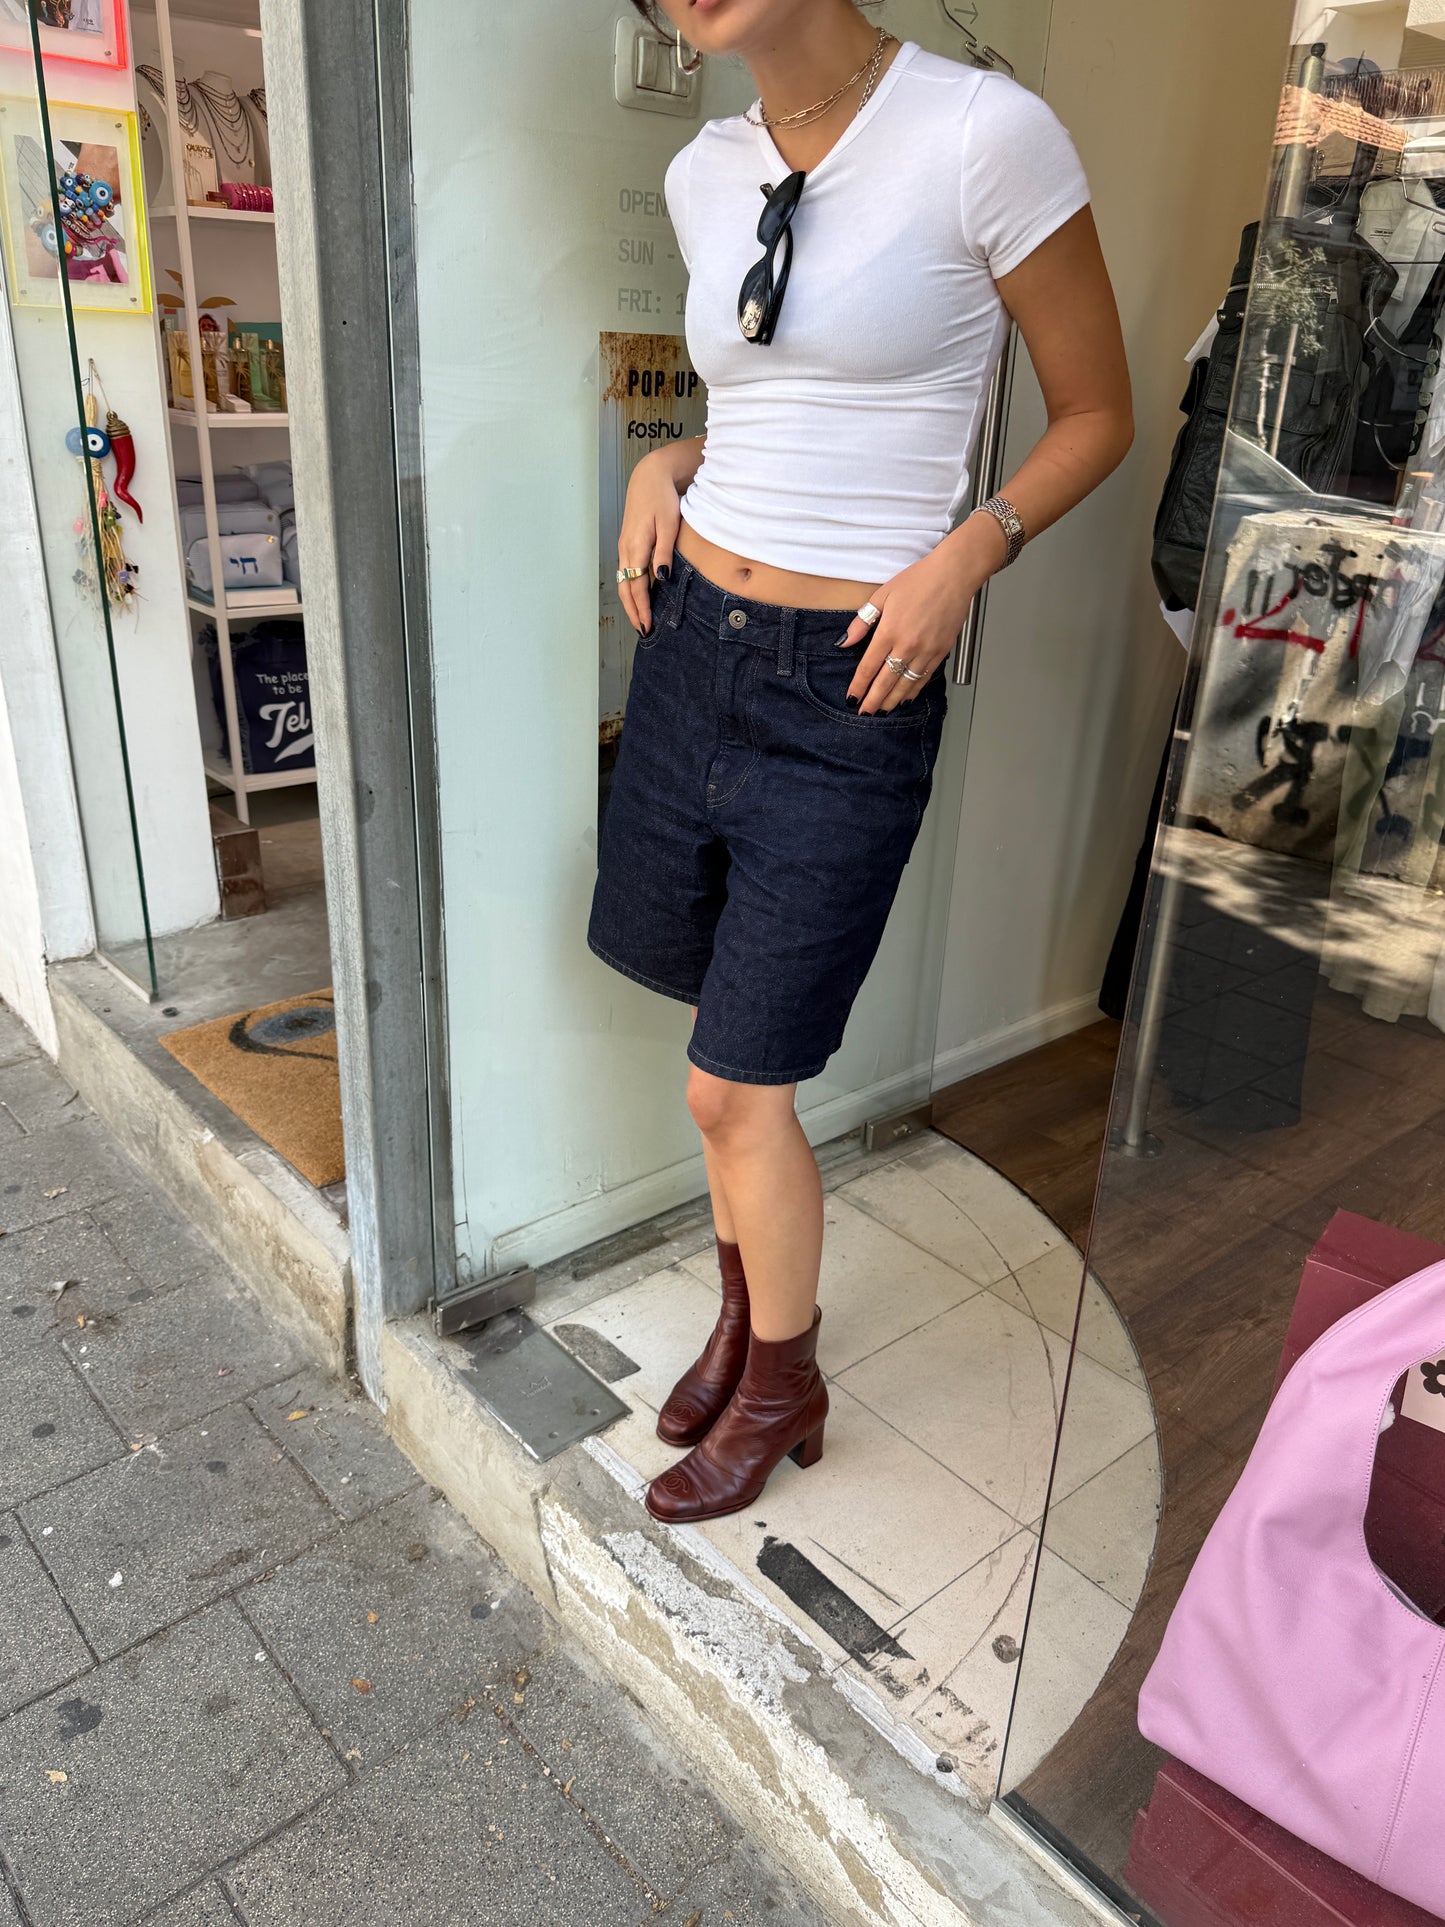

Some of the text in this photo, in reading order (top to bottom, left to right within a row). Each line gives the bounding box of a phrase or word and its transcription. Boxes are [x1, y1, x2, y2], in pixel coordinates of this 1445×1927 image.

[619, 188, 670, 217] OPEN
[618, 238, 654, 265] SUN
[617, 287, 662, 314] FRI:
[628, 369, 698, 398] POP UP
[627, 418, 683, 439] foshu
[229, 557, 259, 575] חי
[256, 673, 279, 684] The
[272, 683, 303, 695] to be
[259, 701, 310, 749] Tel
